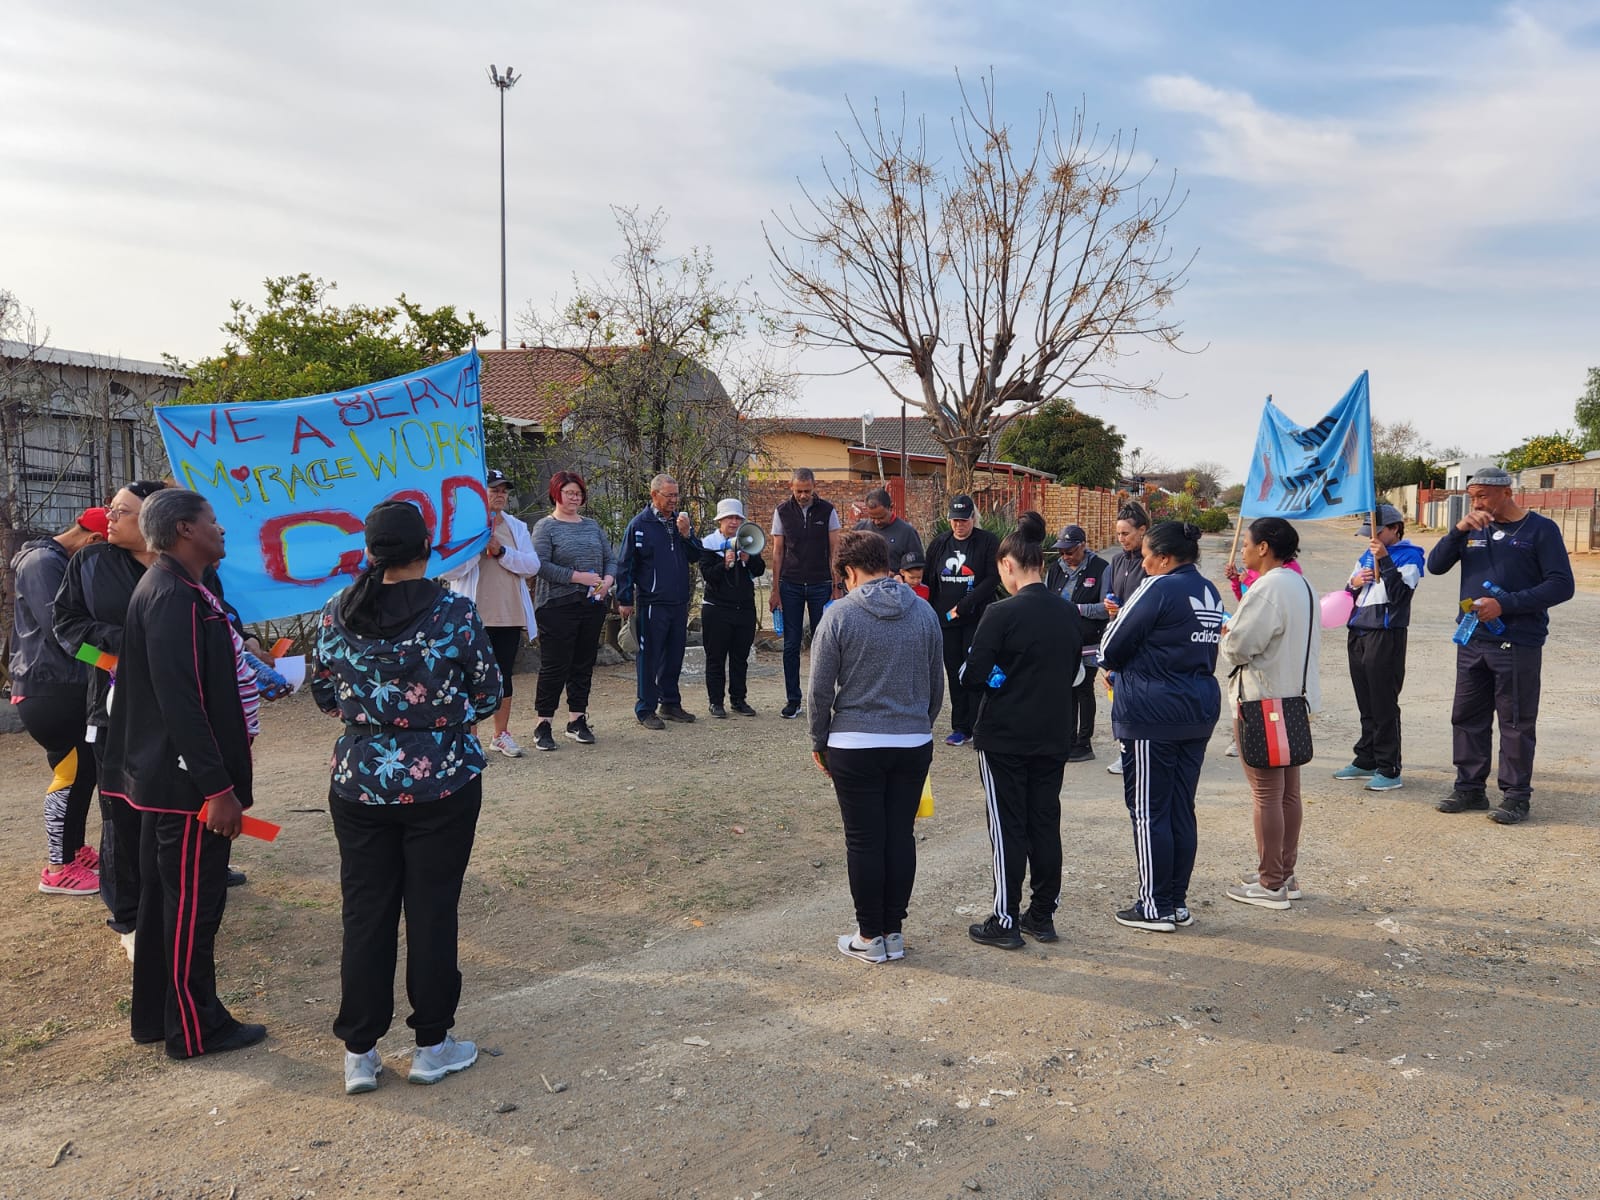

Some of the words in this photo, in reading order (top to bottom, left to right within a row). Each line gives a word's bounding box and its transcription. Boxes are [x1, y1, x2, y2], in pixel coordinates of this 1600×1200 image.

[158, 407, 266, 449] WE
[291, 415, 336, 455] A
[333, 365, 479, 426] SERVE
[1190, 629, 1220, 643] adida
